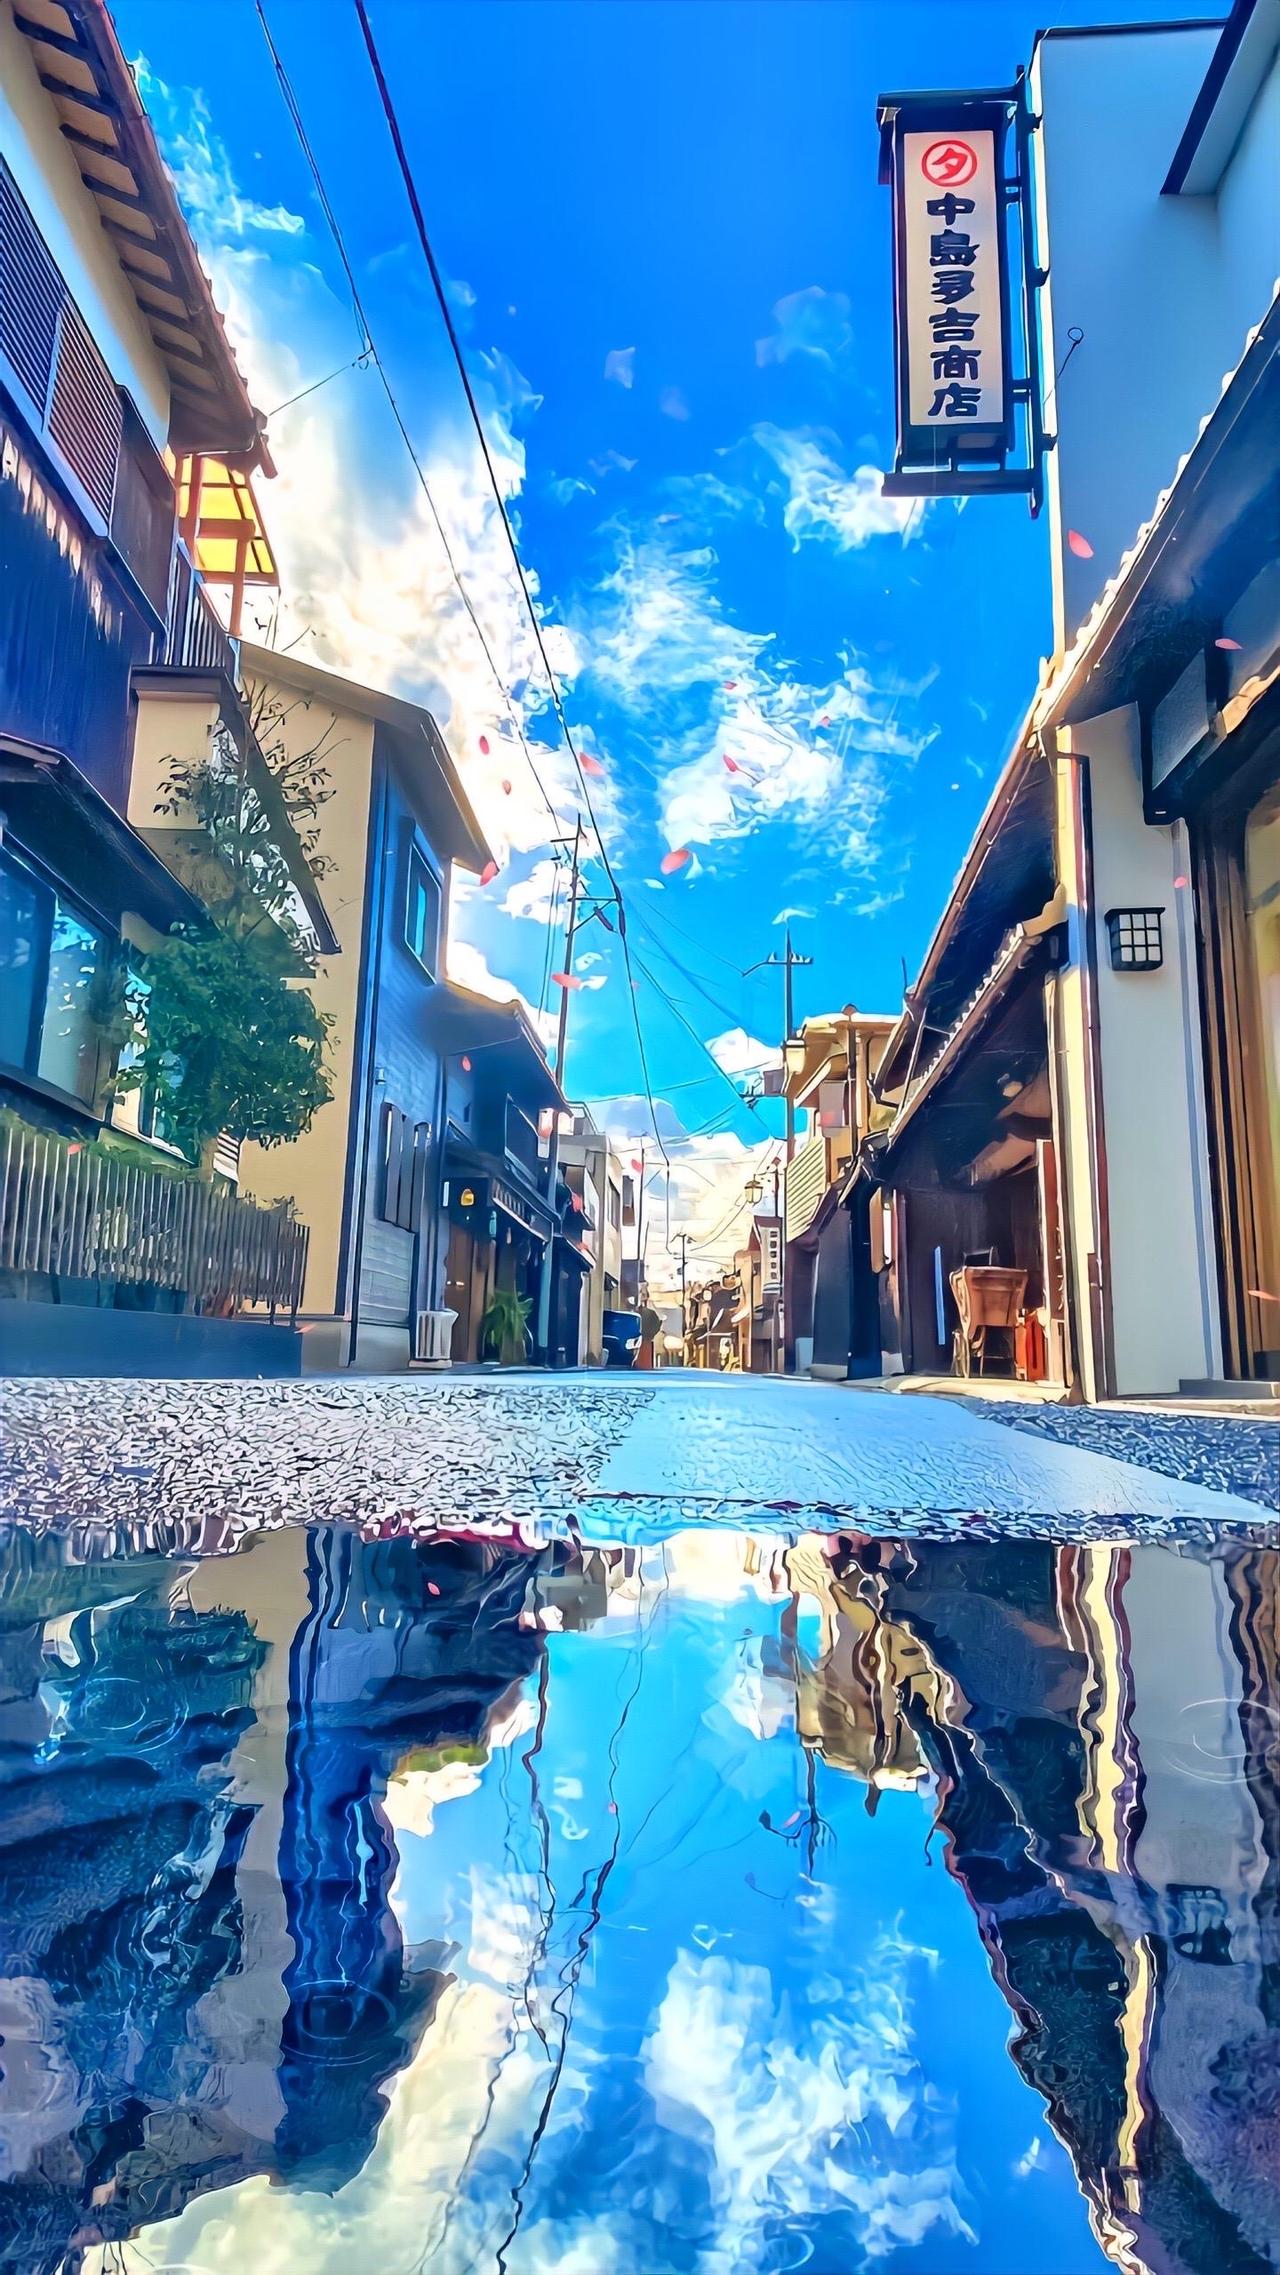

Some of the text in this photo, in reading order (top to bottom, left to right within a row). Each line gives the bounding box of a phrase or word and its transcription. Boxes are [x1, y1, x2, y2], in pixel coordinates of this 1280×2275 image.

[926, 192, 982, 418] 中島多吉商店
